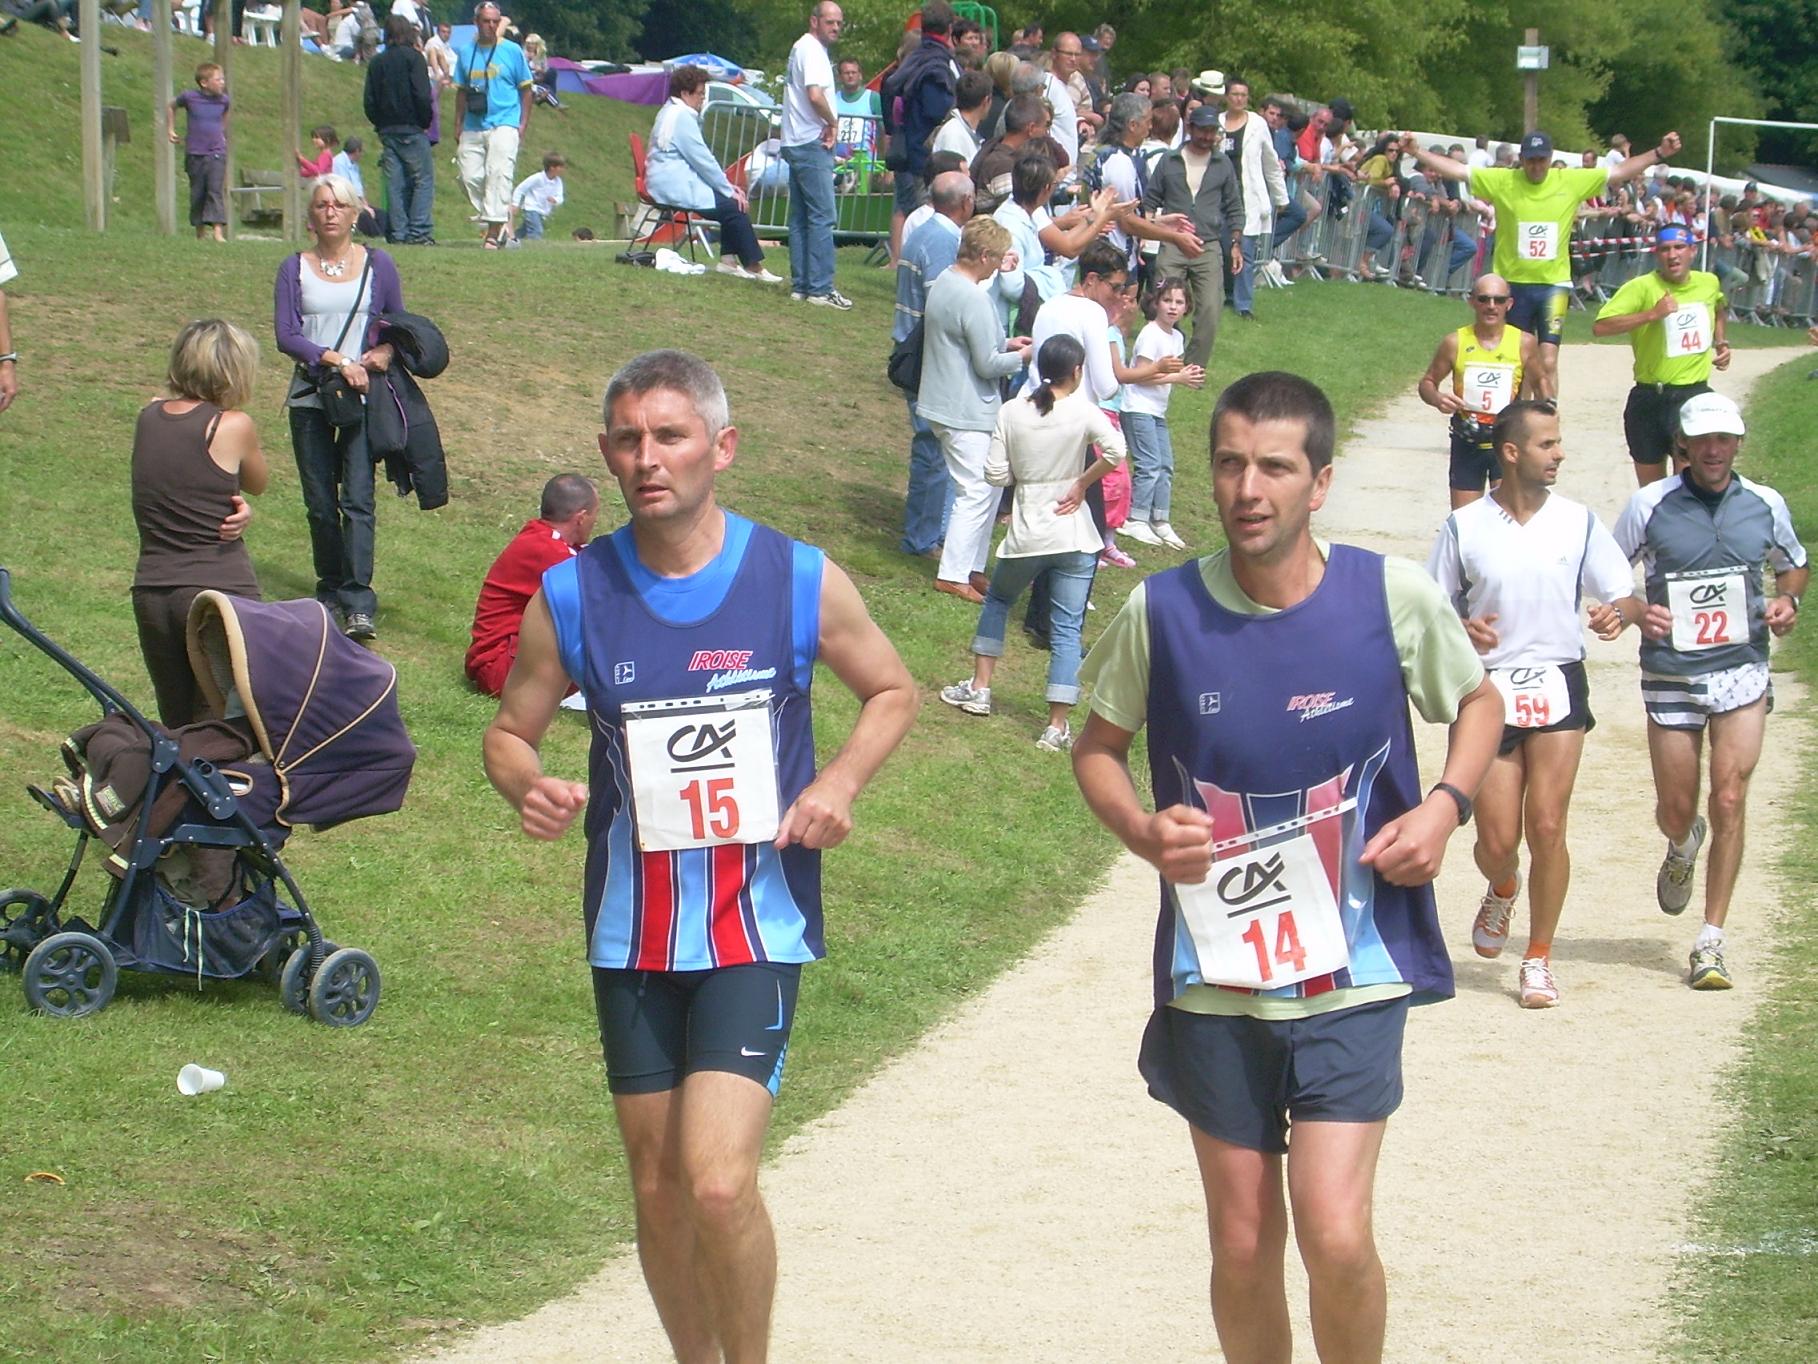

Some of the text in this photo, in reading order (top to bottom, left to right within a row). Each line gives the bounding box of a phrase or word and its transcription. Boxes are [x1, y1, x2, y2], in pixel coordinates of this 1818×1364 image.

[1529, 240, 1546, 257] 52
[1682, 331, 1701, 351] 44
[1482, 390, 1492, 410] 5
[1695, 611, 1729, 644] 22
[688, 650, 753, 671] IROISE
[1286, 692, 1336, 711] IROISE
[1515, 694, 1549, 727] 59
[680, 777, 740, 840] 15
[1242, 910, 1307, 982] 14
